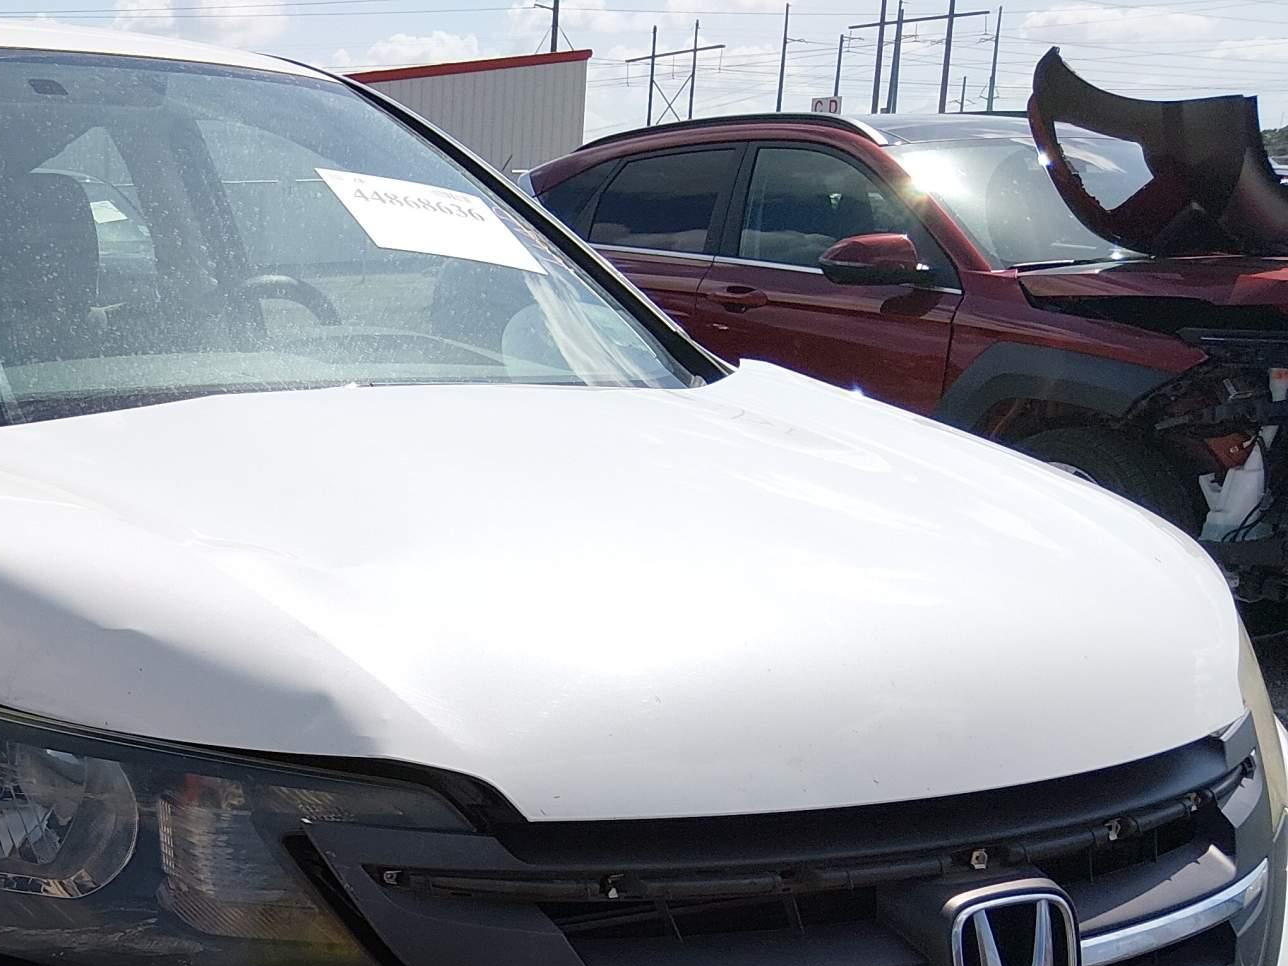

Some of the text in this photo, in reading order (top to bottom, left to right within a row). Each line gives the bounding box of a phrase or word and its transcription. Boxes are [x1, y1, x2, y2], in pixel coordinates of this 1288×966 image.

[814, 99, 838, 114] C D
[353, 187, 486, 222] 44868636
